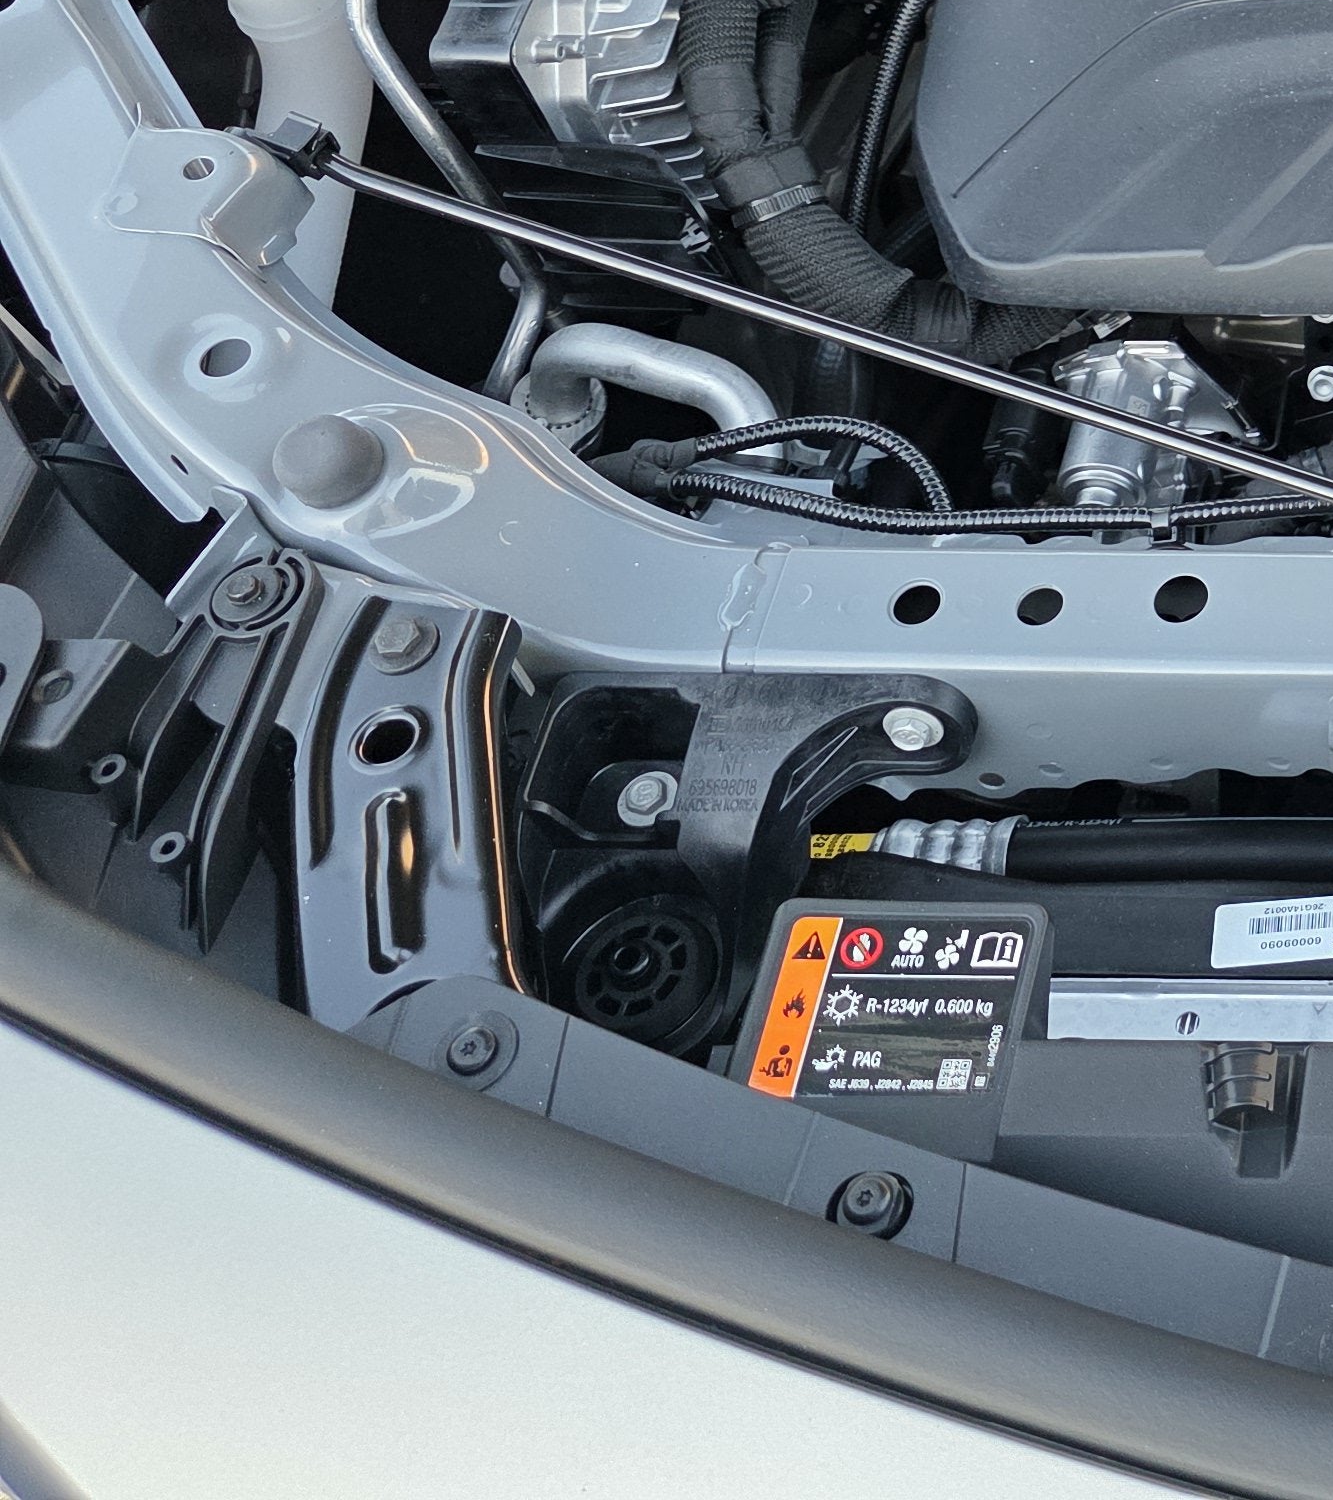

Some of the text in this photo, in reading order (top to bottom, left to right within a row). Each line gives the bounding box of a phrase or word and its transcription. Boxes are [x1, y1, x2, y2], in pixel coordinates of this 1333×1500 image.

[891, 954, 925, 969] AUTO
[866, 998, 994, 1017] R-1234yf 0.600 kg
[852, 1051, 882, 1068] PAG
[828, 1078, 847, 1090] SAE
